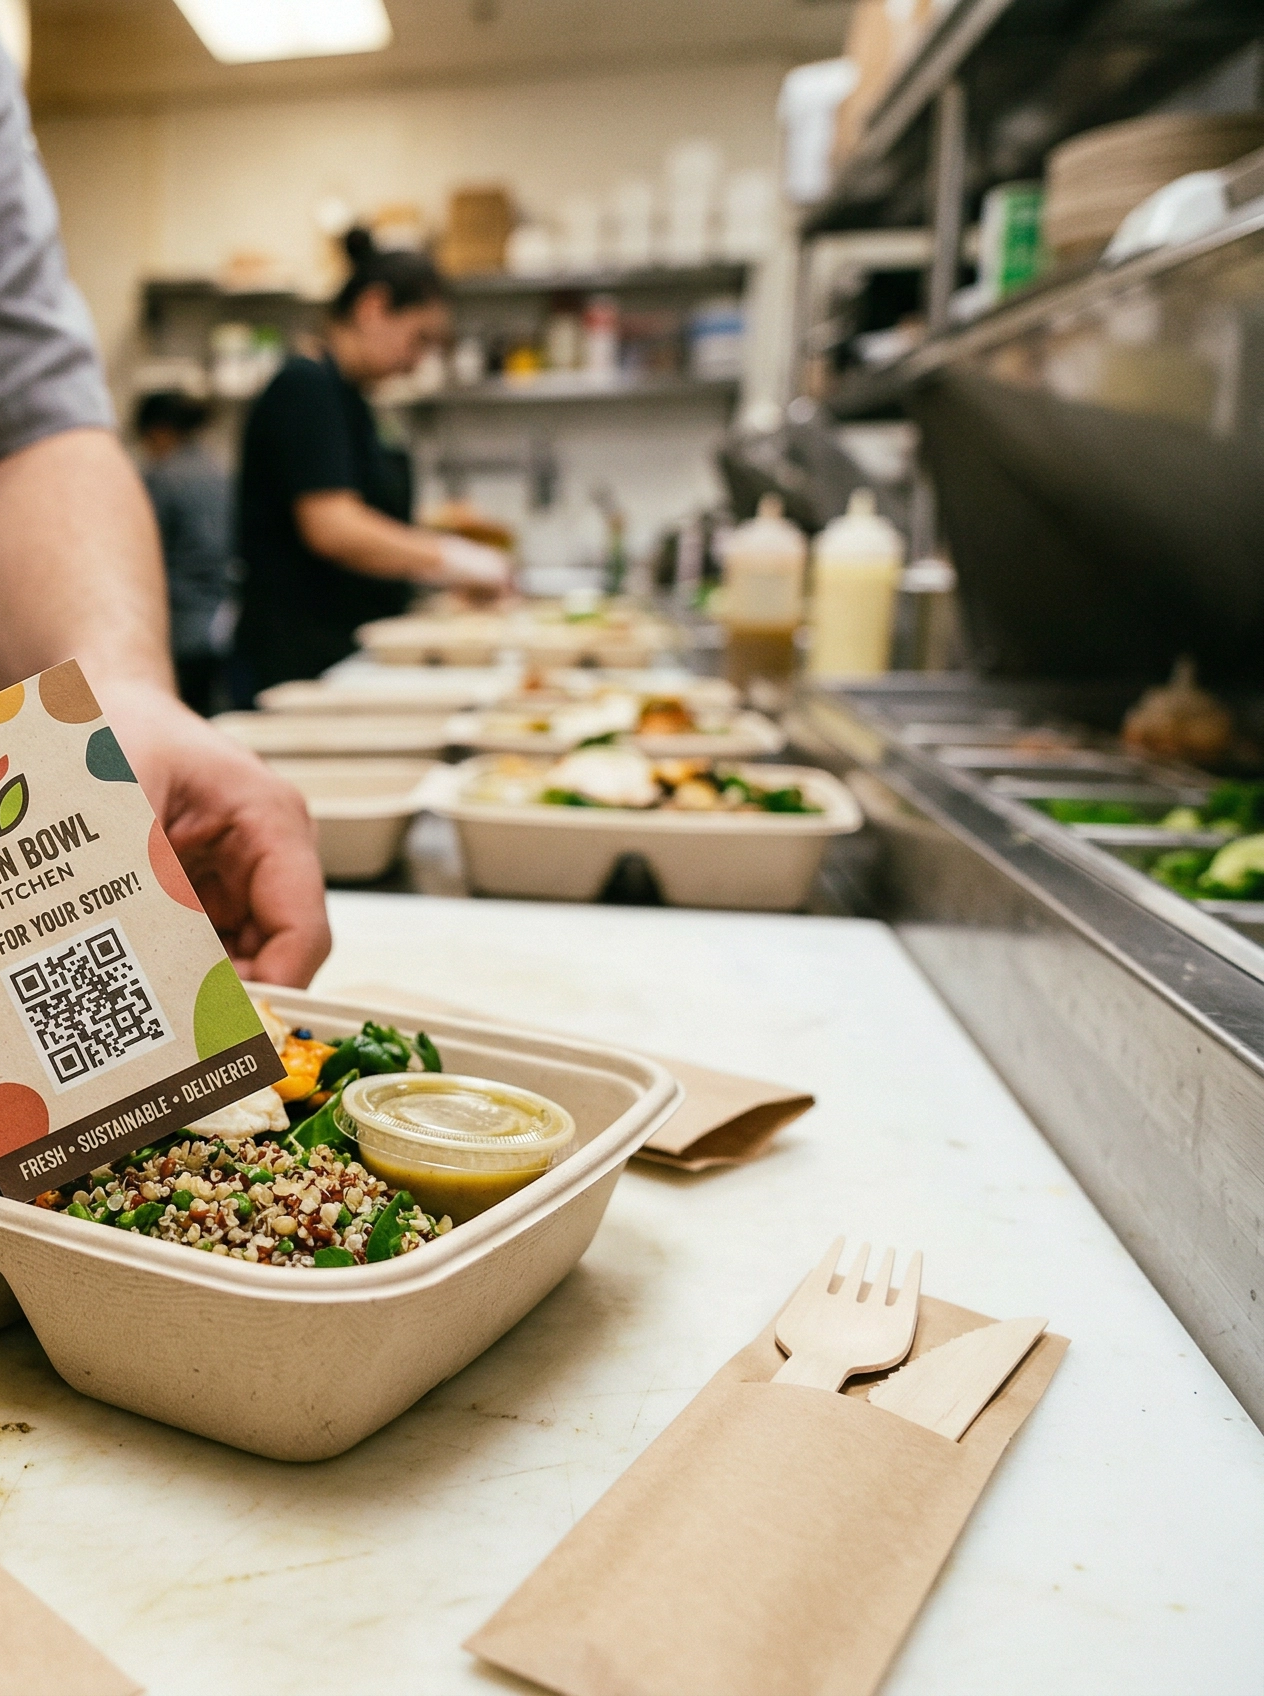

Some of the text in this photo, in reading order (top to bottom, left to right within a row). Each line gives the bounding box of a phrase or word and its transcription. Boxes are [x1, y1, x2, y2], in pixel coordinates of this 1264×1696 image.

[17, 812, 100, 869] BOWL
[29, 901, 80, 937] YOUR
[79, 871, 142, 915] STORY!
[19, 1054, 258, 1180] FRESH SUSTAINABLE DELIVERED
